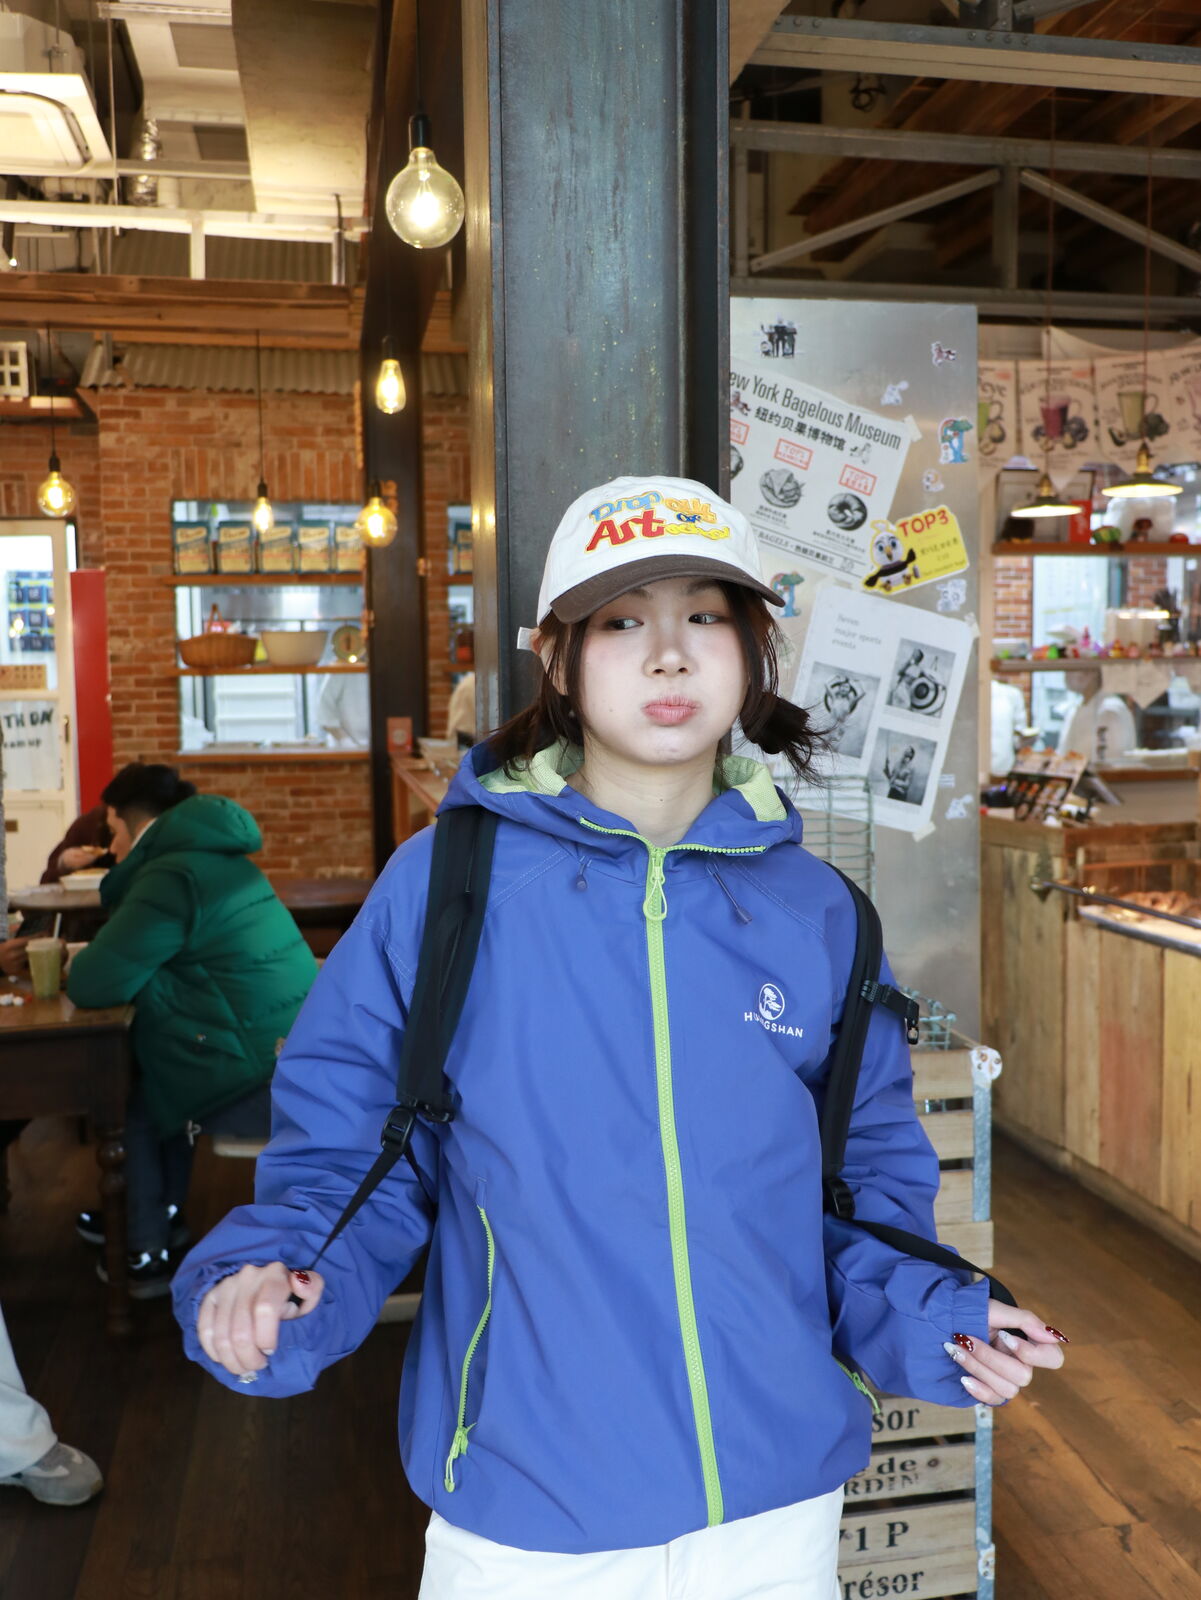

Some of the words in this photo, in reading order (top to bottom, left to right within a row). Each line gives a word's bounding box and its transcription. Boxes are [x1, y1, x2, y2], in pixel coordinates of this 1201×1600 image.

[753, 375, 780, 403] York
[782, 388, 844, 428] Bagelous
[844, 412, 901, 450] Museum
[755, 405, 846, 451] 纽约贝果博物馆
[590, 490, 661, 522] Drop
[586, 509, 665, 552] Art
[898, 509, 949, 537] TOP3
[872, 1407, 919, 1433] sor
[877, 1457, 917, 1475] de
[885, 1521, 909, 1548] P
[838, 1570, 924, 1600] résor
